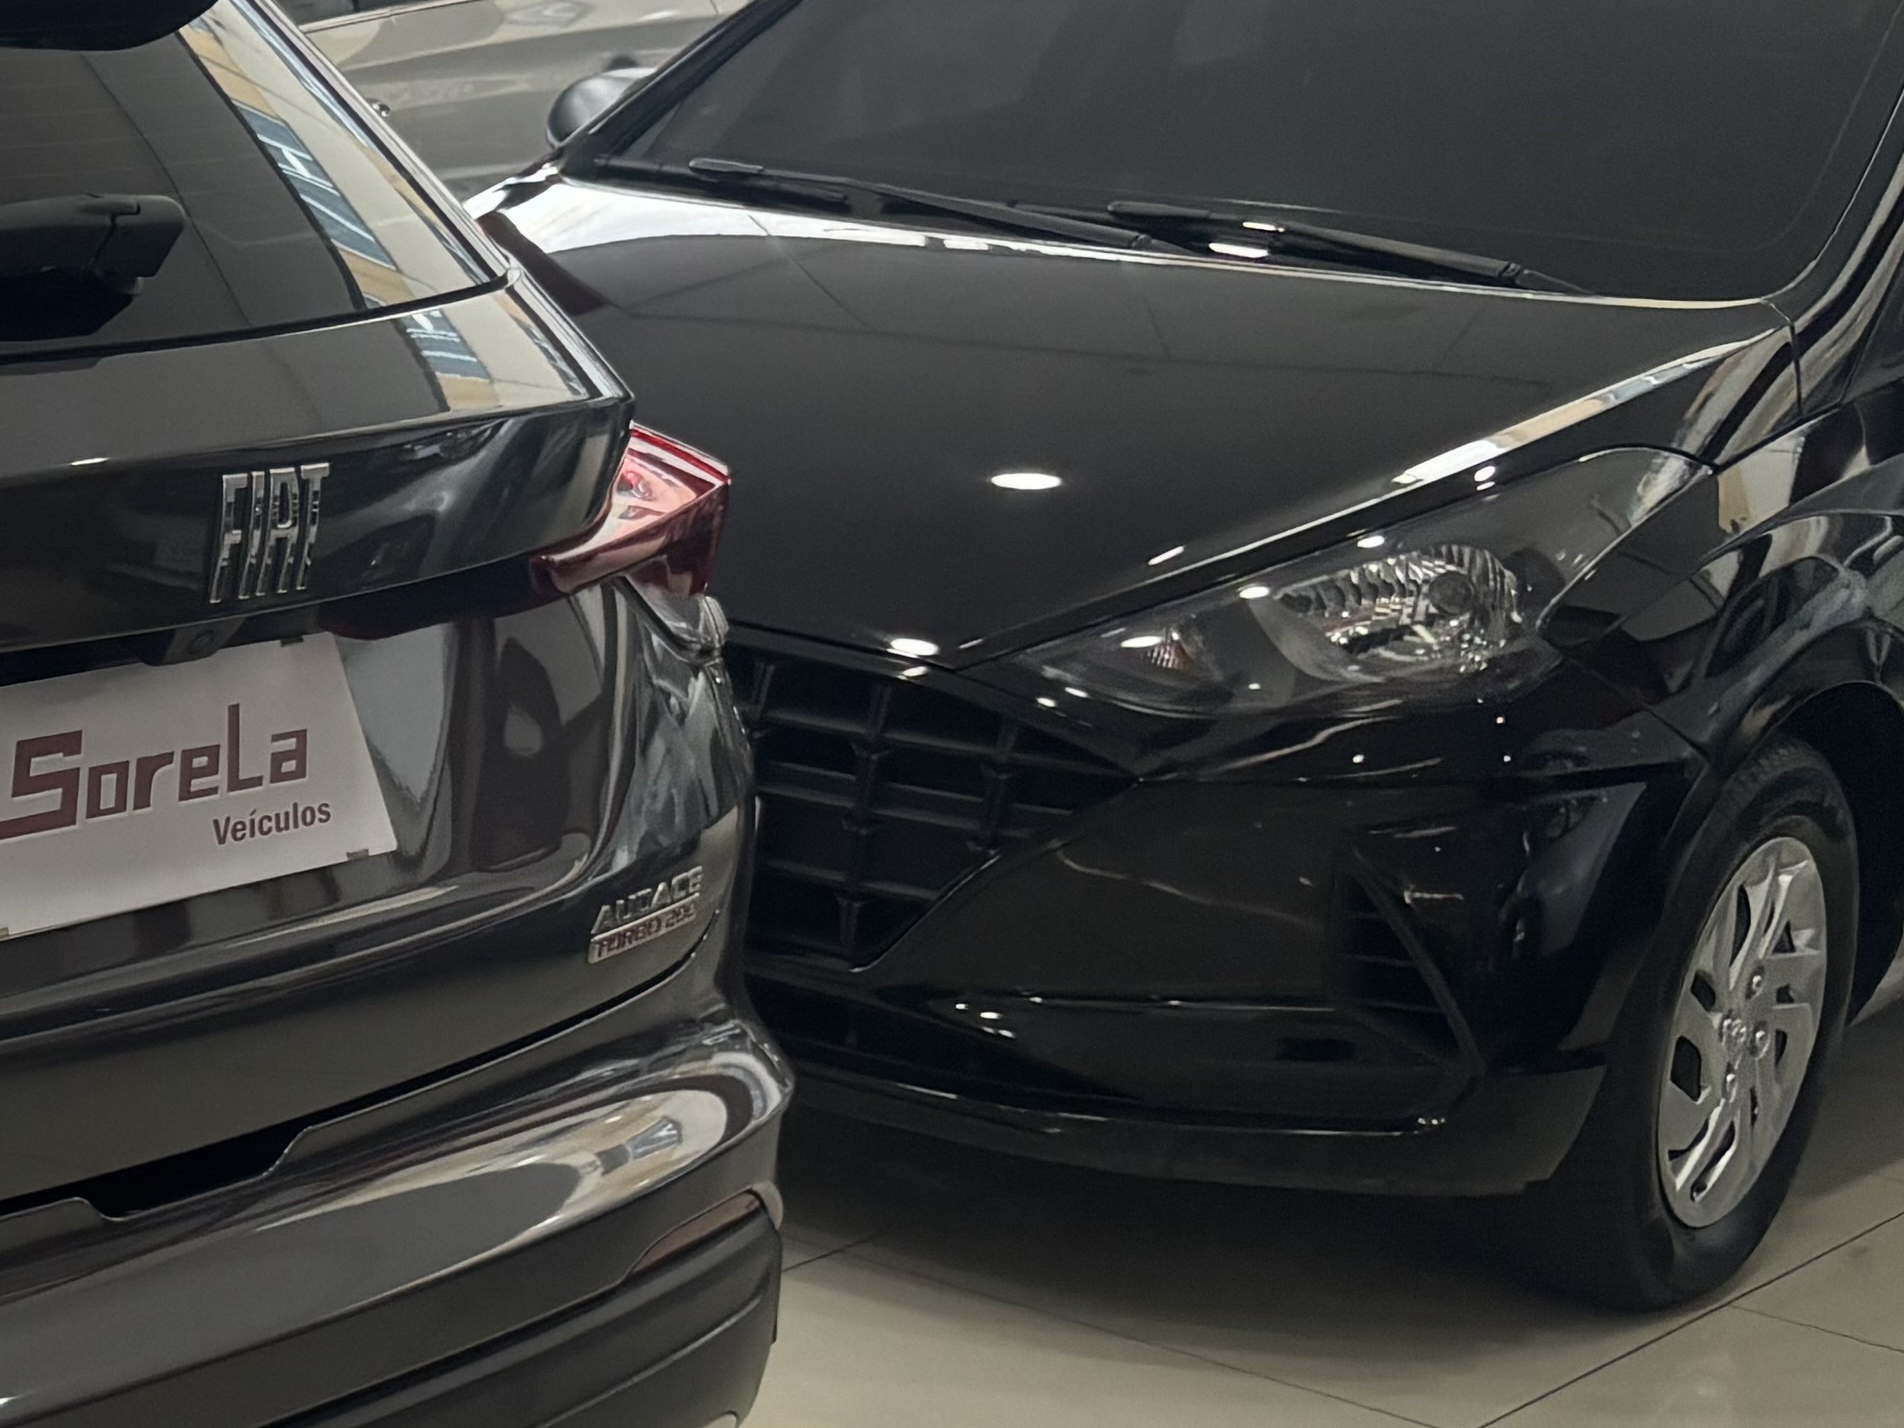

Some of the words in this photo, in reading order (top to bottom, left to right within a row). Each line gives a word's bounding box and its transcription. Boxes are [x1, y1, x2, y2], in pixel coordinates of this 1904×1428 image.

[208, 461, 331, 604] FIAT
[211, 798, 333, 847] Veículos
[590, 865, 703, 935] AUDACE
